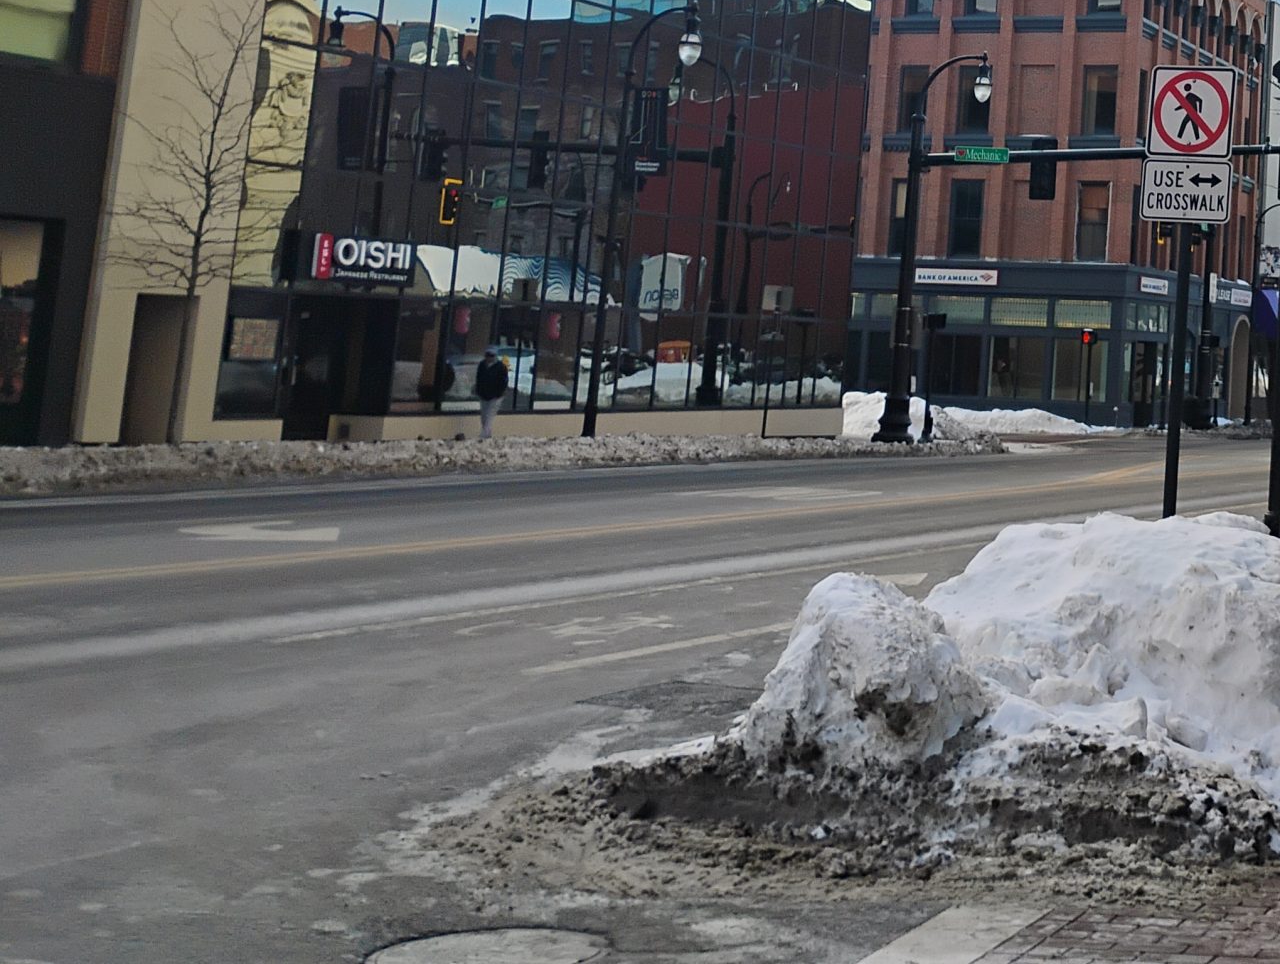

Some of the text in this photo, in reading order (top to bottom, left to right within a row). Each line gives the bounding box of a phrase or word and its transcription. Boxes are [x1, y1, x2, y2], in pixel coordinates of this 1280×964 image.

[966, 148, 1001, 161] Mechanic
[1154, 170, 1185, 187] USE
[1147, 192, 1225, 212] CROSSWALK
[335, 238, 411, 269] OISHI
